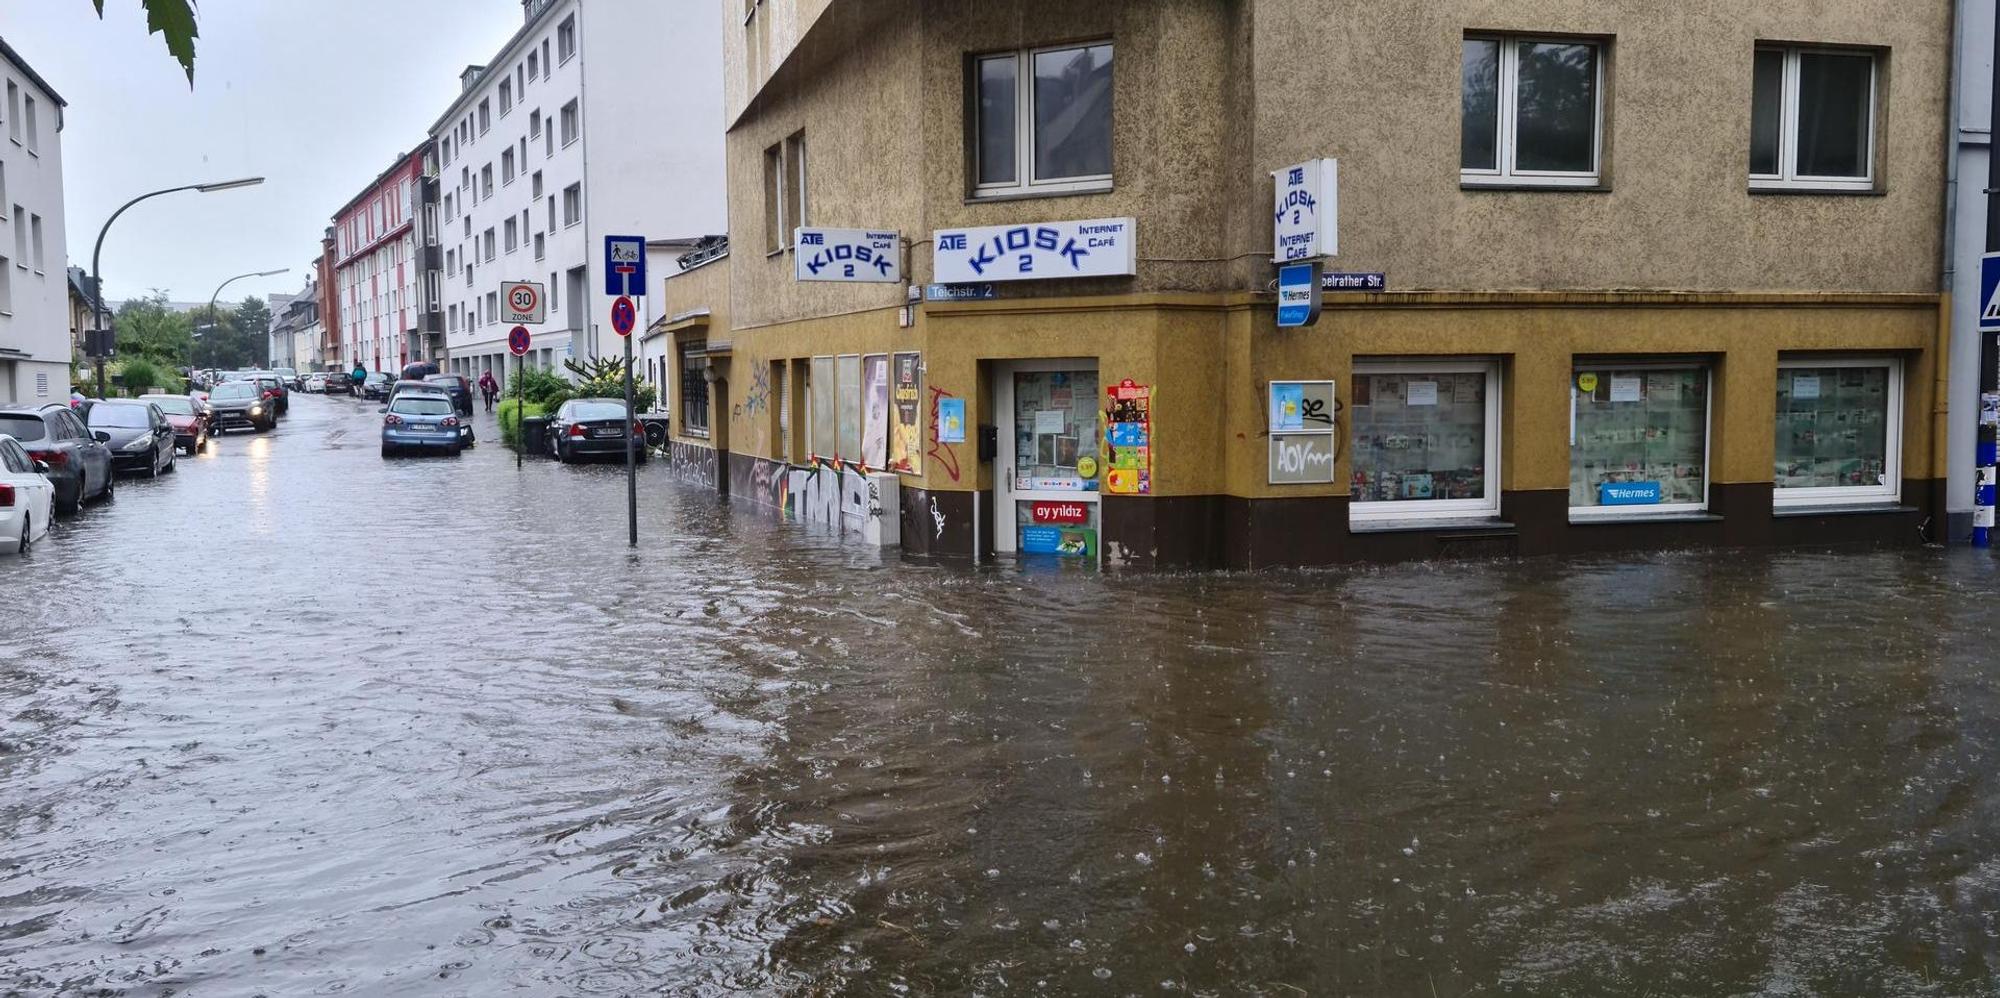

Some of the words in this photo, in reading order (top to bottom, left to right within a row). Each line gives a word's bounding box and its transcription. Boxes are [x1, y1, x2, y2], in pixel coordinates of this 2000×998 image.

[1288, 167, 1303, 187] ATE
[1276, 189, 1316, 224] KIOSK
[1293, 209, 1300, 225] 2
[866, 232, 897, 240] INTERNET
[1079, 223, 1124, 235] INTERNET
[800, 233, 824, 245] ATE
[938, 234, 967, 250] ATE
[1088, 236, 1115, 248] CAFÉ
[1280, 231, 1314, 247] INTERNET
[968, 227, 1090, 276] KIOSK
[1286, 244, 1308, 259] CAFÉ
[806, 244, 894, 277] KIOSK
[1018, 254, 1033, 273] 2
[844, 264, 855, 278] 2
[1367, 274, 1383, 288] Str.
[514, 292, 531, 305] 30
[932, 285, 977, 299] Teichstr.
[984, 284, 993, 297] 2
[1288, 290, 1310, 301] Hermes
[512, 313, 533, 321] ZONE
[1618, 488, 1655, 499] Hermes
[1037, 506, 1051, 520] ay
[1052, 504, 1082, 520] yıldız
